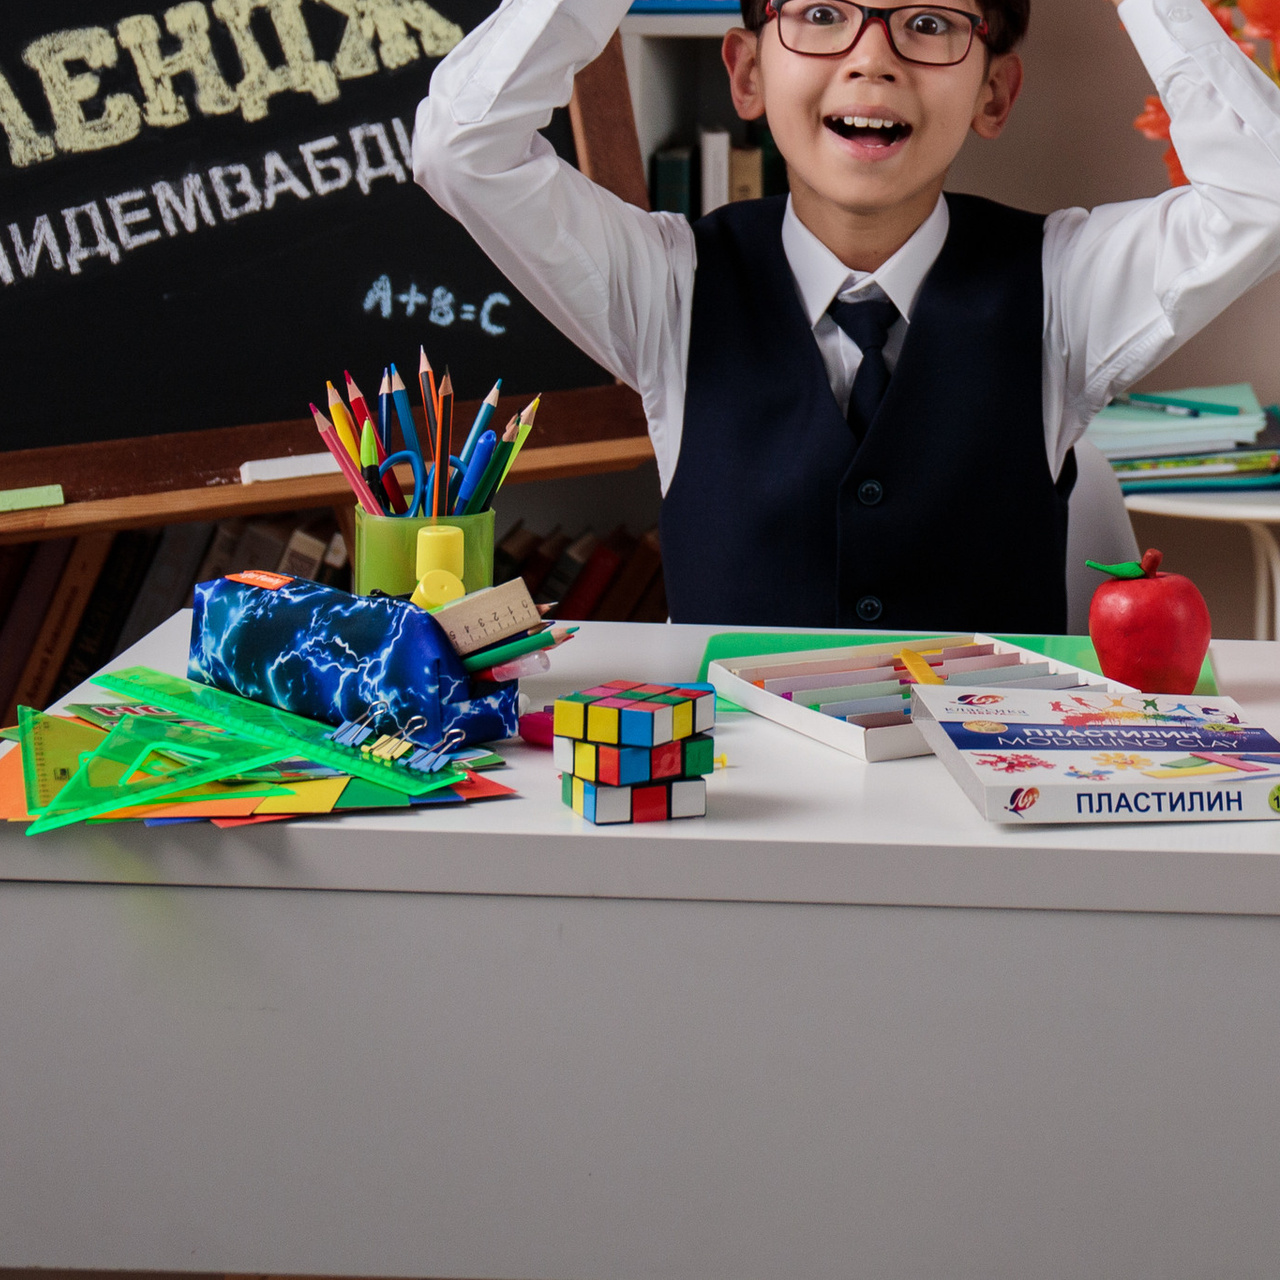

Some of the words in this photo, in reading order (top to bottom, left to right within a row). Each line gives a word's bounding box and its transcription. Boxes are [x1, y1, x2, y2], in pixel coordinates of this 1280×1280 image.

[521, 600, 528, 608] 0
[507, 606, 514, 615] 1
[492, 612, 499, 621] 2
[478, 618, 485, 627] 3
[464, 625, 470, 633] 4
[449, 631, 456, 640] 5
[1022, 726, 1201, 739] ПЛАСТИЛИН
[998, 735, 1167, 748] MODELLING
[1177, 738, 1239, 749] CLAY
[1077, 791, 1242, 814] ПЛАСТИЛИН
